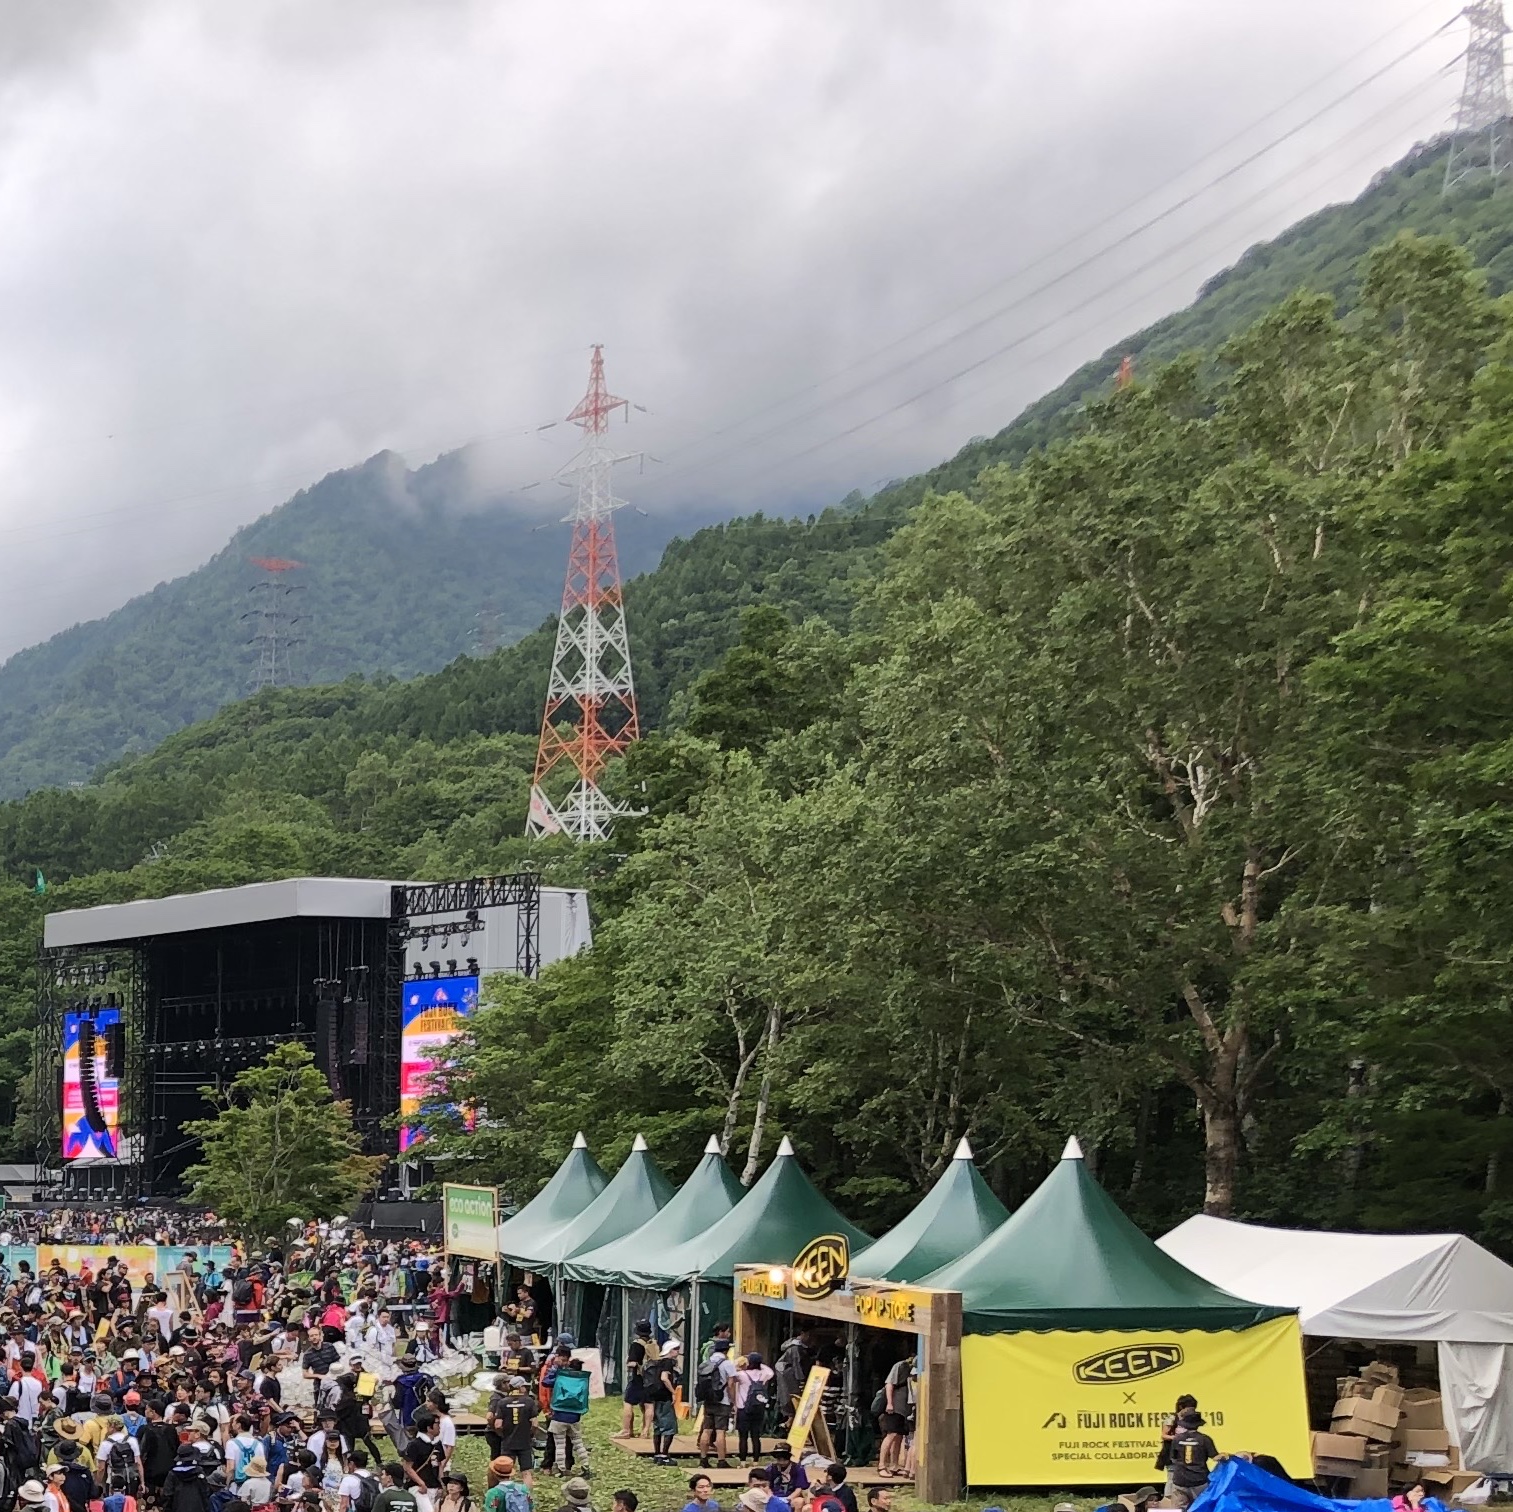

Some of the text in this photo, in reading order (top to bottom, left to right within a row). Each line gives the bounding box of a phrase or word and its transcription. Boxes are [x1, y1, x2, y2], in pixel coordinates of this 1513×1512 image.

[464, 1196, 492, 1217] action
[794, 1245, 845, 1290] KEEN
[854, 1294, 871, 1315] POP
[884, 1299, 914, 1322] STORE
[1079, 1349, 1177, 1380] KEEN
[1077, 1412, 1106, 1429] FUJI
[1109, 1412, 1145, 1428] ROCK
[1059, 1441, 1080, 1449] FUJI
[1082, 1441, 1109, 1449] ROCK
